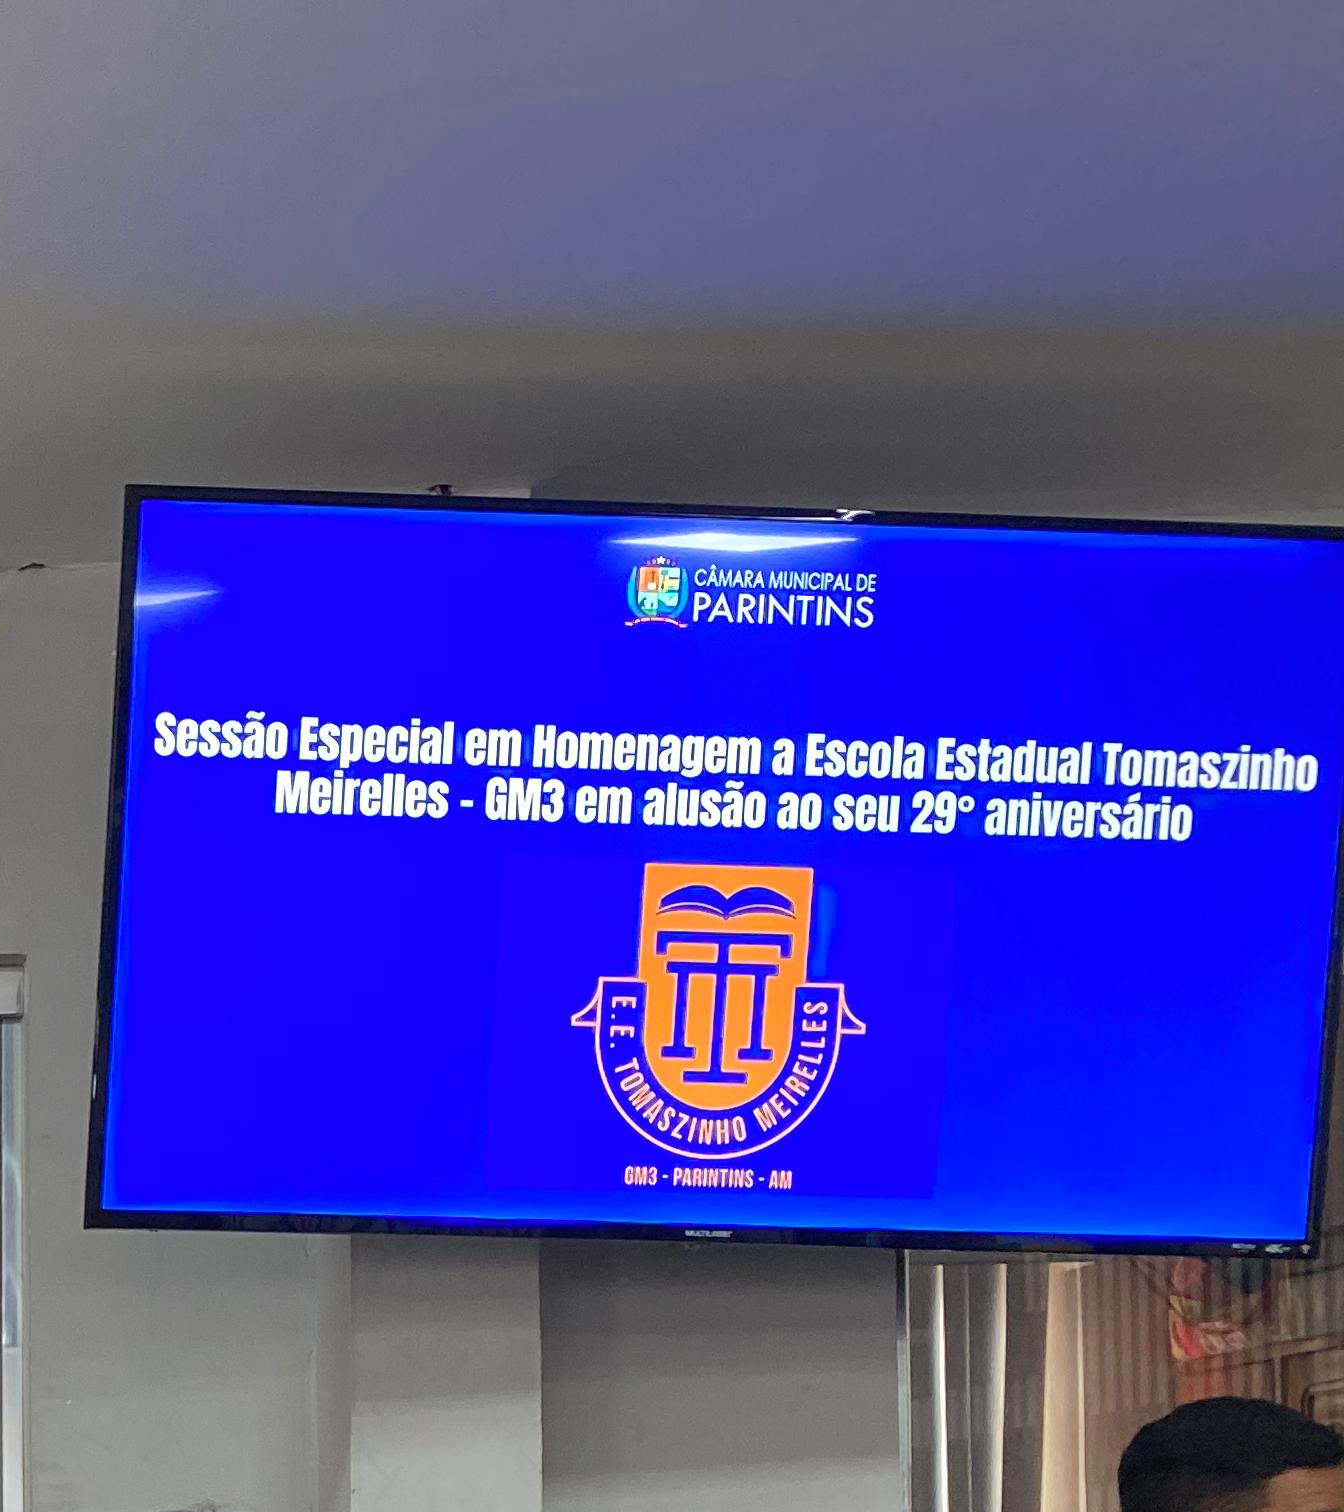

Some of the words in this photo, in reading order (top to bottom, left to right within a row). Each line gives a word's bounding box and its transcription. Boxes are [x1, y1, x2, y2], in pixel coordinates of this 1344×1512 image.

[694, 564, 765, 588] CÂMARA
[768, 570, 853, 592] MUNICIPAL
[856, 573, 877, 592] DE
[692, 592, 874, 628] PARINTINS
[154, 711, 288, 760] Sessão
[299, 717, 454, 768] Especial
[464, 728, 522, 767] em
[533, 725, 762, 779] Homenagem
[772, 738, 795, 776] a
[805, 733, 925, 780] Escola
[936, 737, 1092, 785] Estadual
[1103, 743, 1319, 792] Tomaszinho
[275, 770, 449, 819] Meirelles
[485, 777, 565, 823] GM3
[575, 786, 632, 825] em
[643, 781, 765, 830] alusão
[777, 791, 822, 831] ao
[833, 794, 900, 833] seu
[985, 792, 1193, 842] aniversário
[614, 1057, 748, 1146] TOMASZINHO
[752, 1001, 830, 1133] MEIRELLES
[624, 1166, 659, 1187] GM3
[673, 1167, 755, 1189] PARINTINS
[768, 1170, 793, 1190] AM
